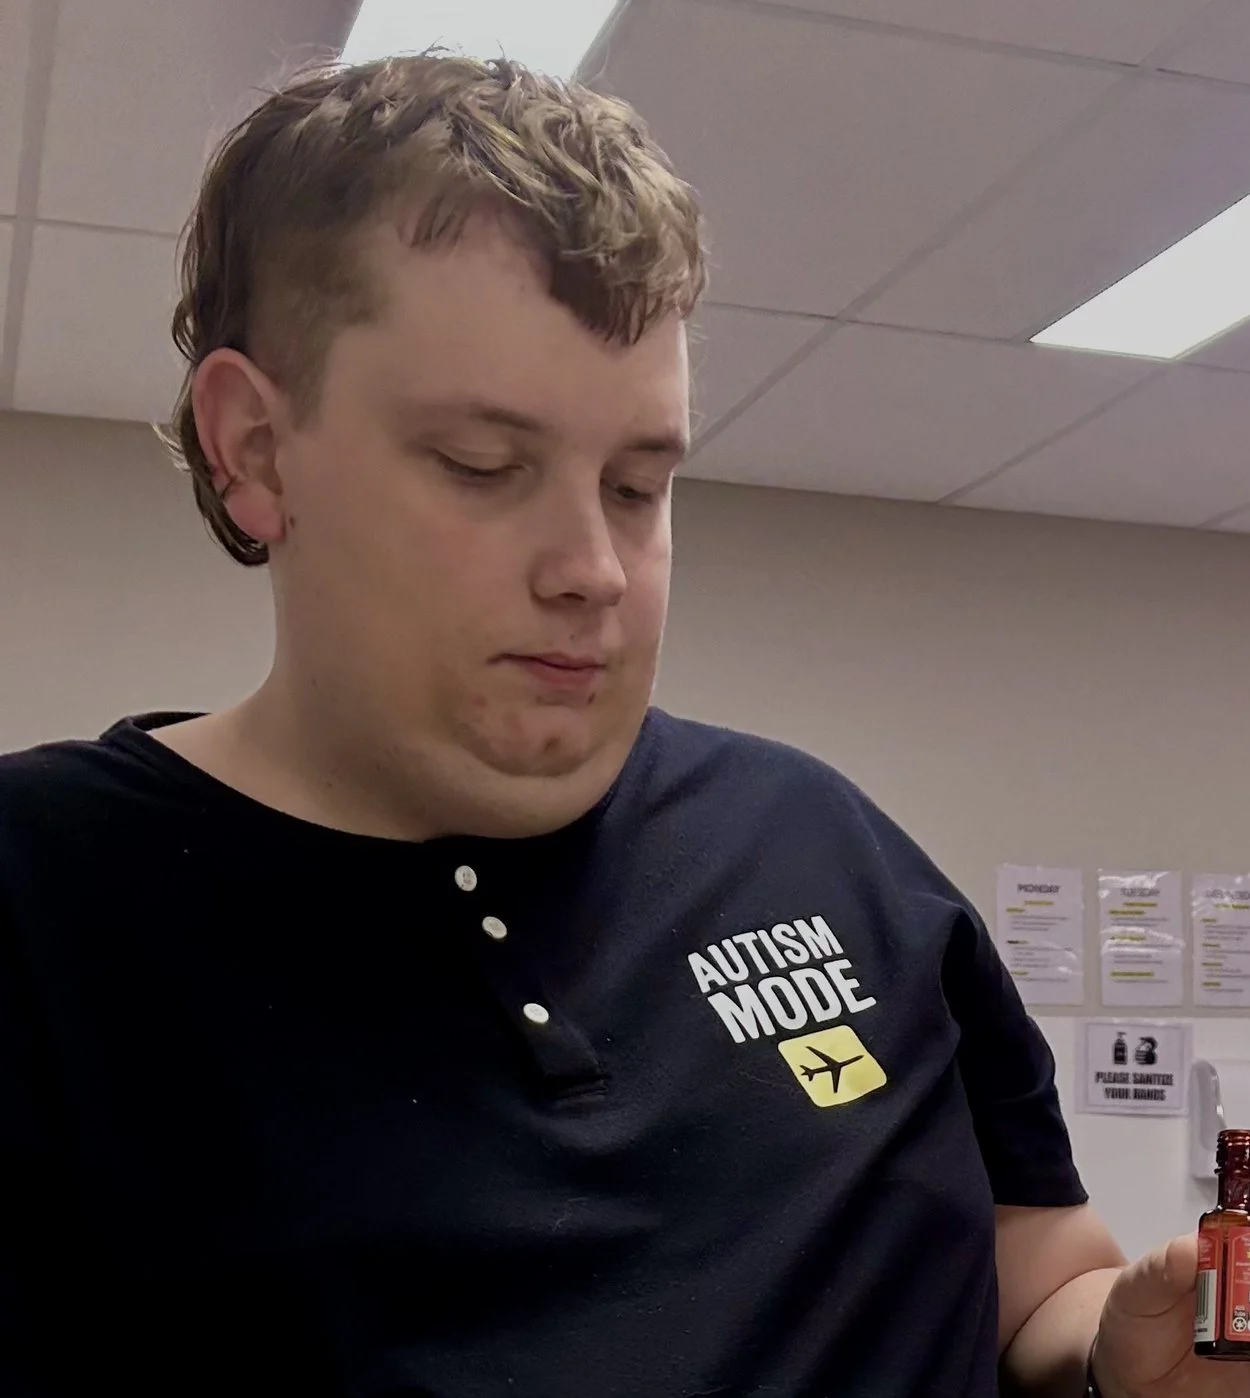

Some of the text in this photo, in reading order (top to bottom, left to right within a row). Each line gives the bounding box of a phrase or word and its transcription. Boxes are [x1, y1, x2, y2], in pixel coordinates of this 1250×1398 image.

[687, 915, 844, 994] AUTISM
[707, 959, 877, 1043] MODE
[1095, 1071, 1130, 1084] PLEASE
